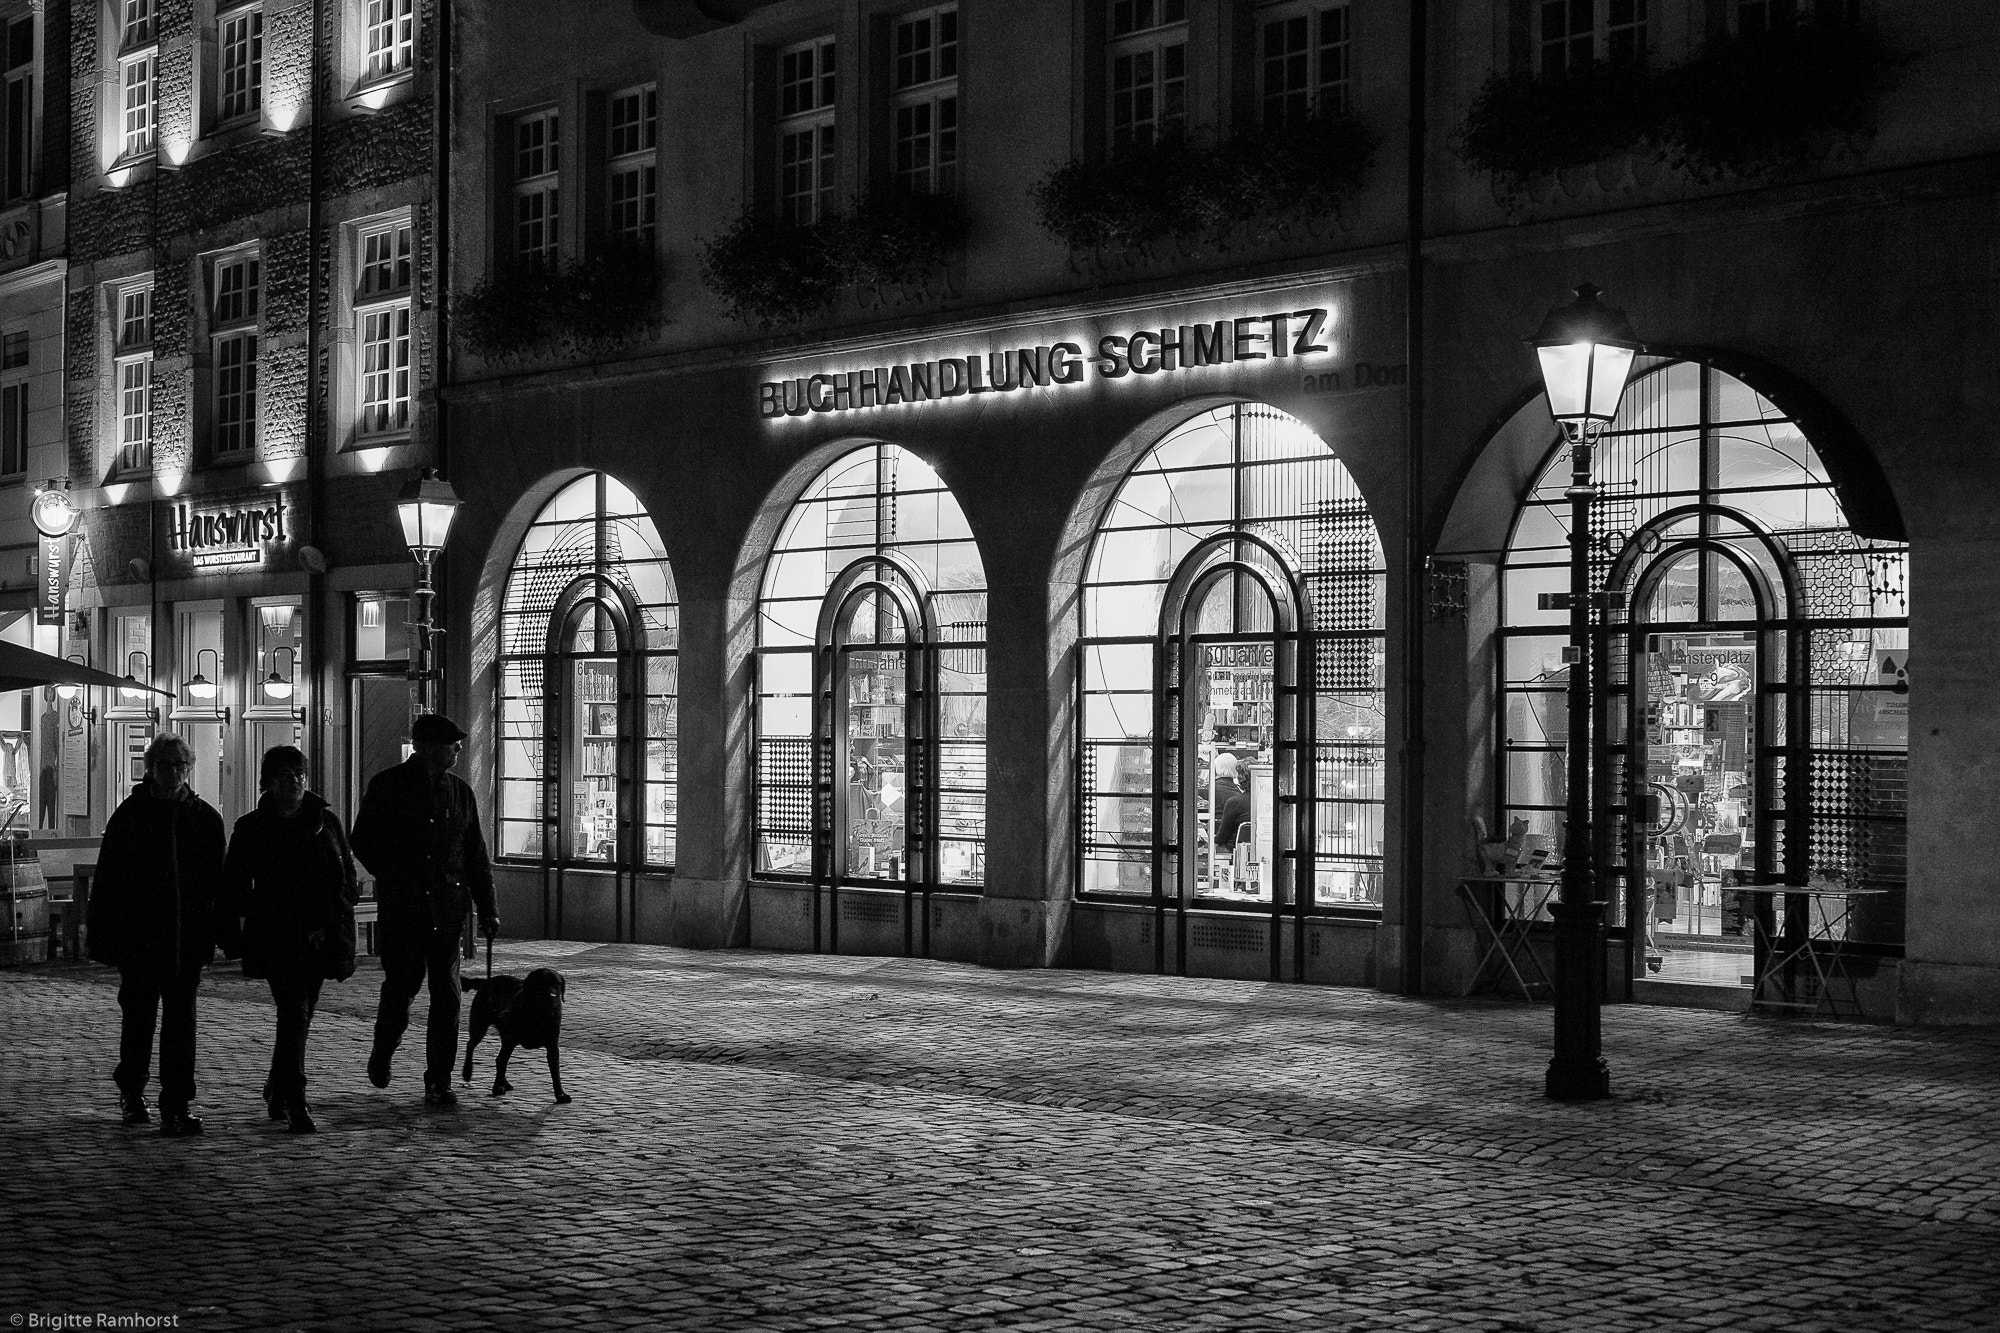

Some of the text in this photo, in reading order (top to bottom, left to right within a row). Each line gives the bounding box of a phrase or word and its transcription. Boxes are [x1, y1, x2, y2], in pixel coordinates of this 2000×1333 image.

[759, 308, 1329, 419] BUCHHANDLUNG SCHMETZ
[1303, 372, 1340, 394] am
[168, 492, 287, 550] Hanswurst
[43, 536, 61, 620] Hanswurst
[872, 654, 906, 671] Jahre
[1205, 646, 1274, 664] 60 Jahre
